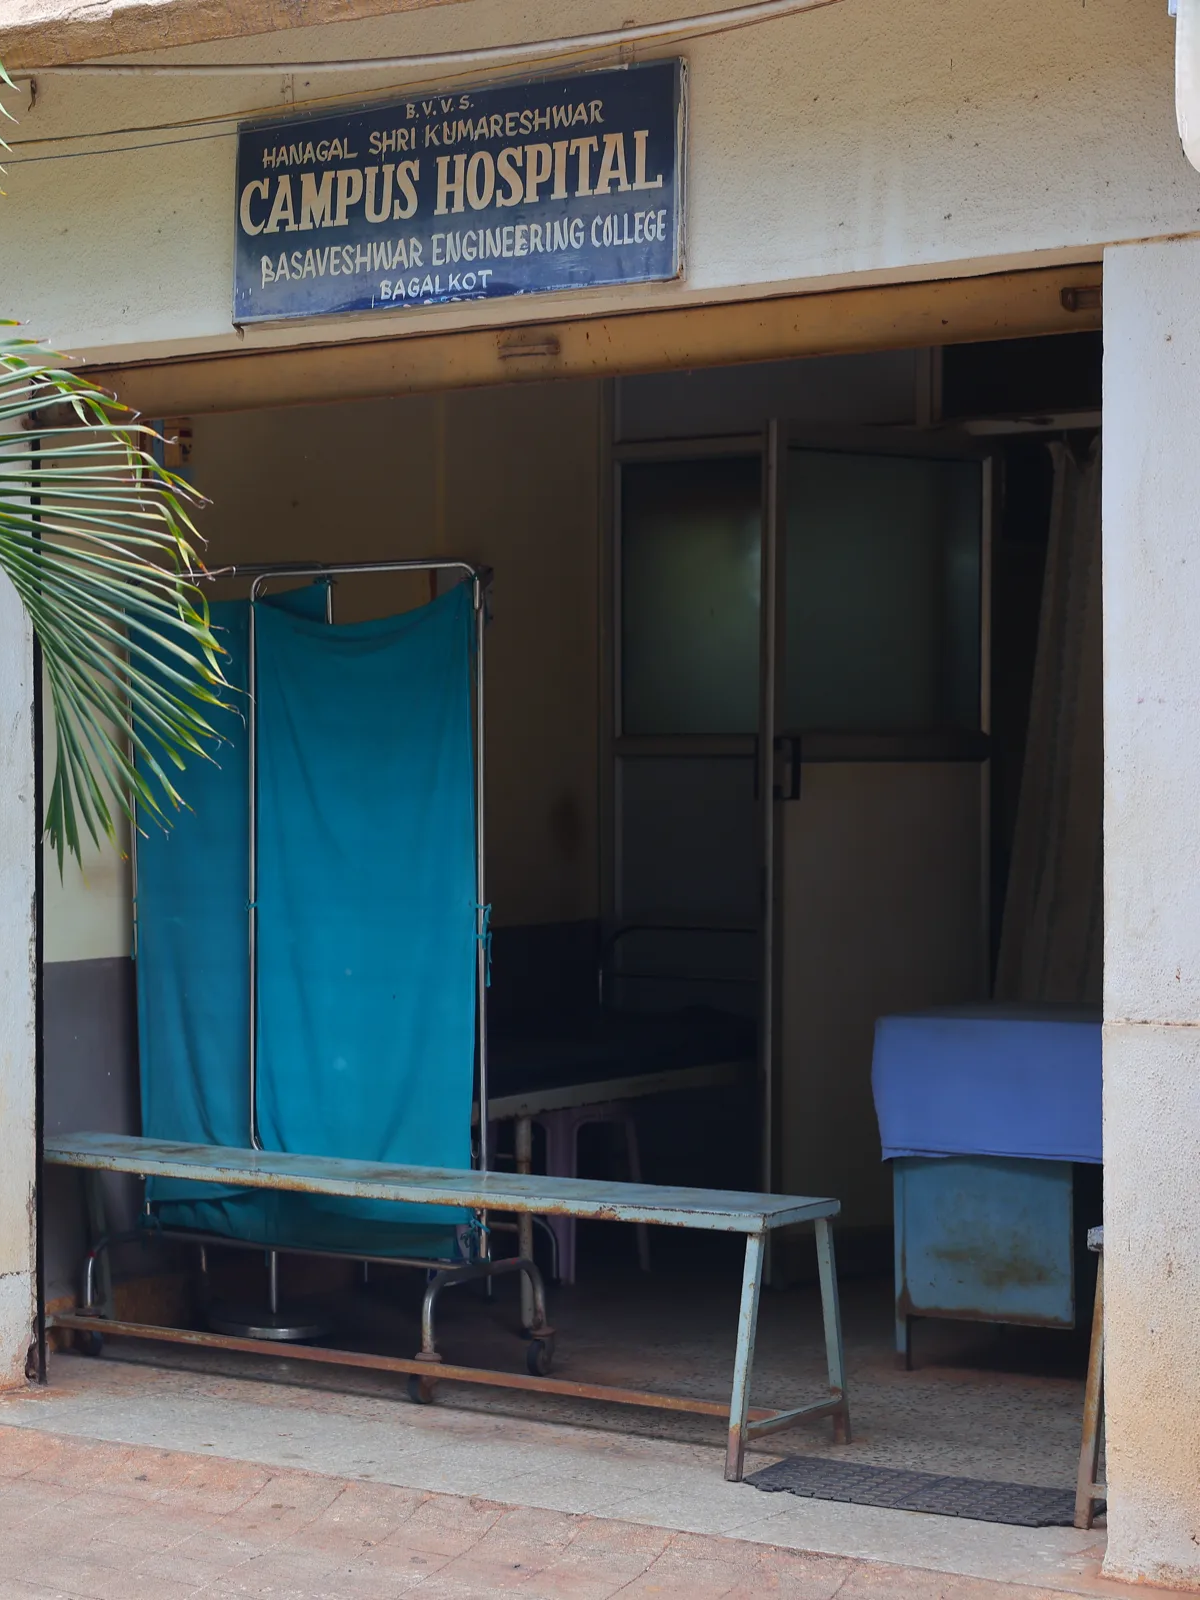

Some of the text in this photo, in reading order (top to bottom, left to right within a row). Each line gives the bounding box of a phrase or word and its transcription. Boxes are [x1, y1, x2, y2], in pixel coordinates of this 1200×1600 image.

[262, 99, 605, 168] HANAGAL SHRI KUMARESHWAR
[240, 129, 663, 236] CAMPUS HOSPITAL
[260, 209, 667, 290] BASAVESHWAR ENGINEERING COLLEGE
[379, 270, 493, 300] BAGALKOT
